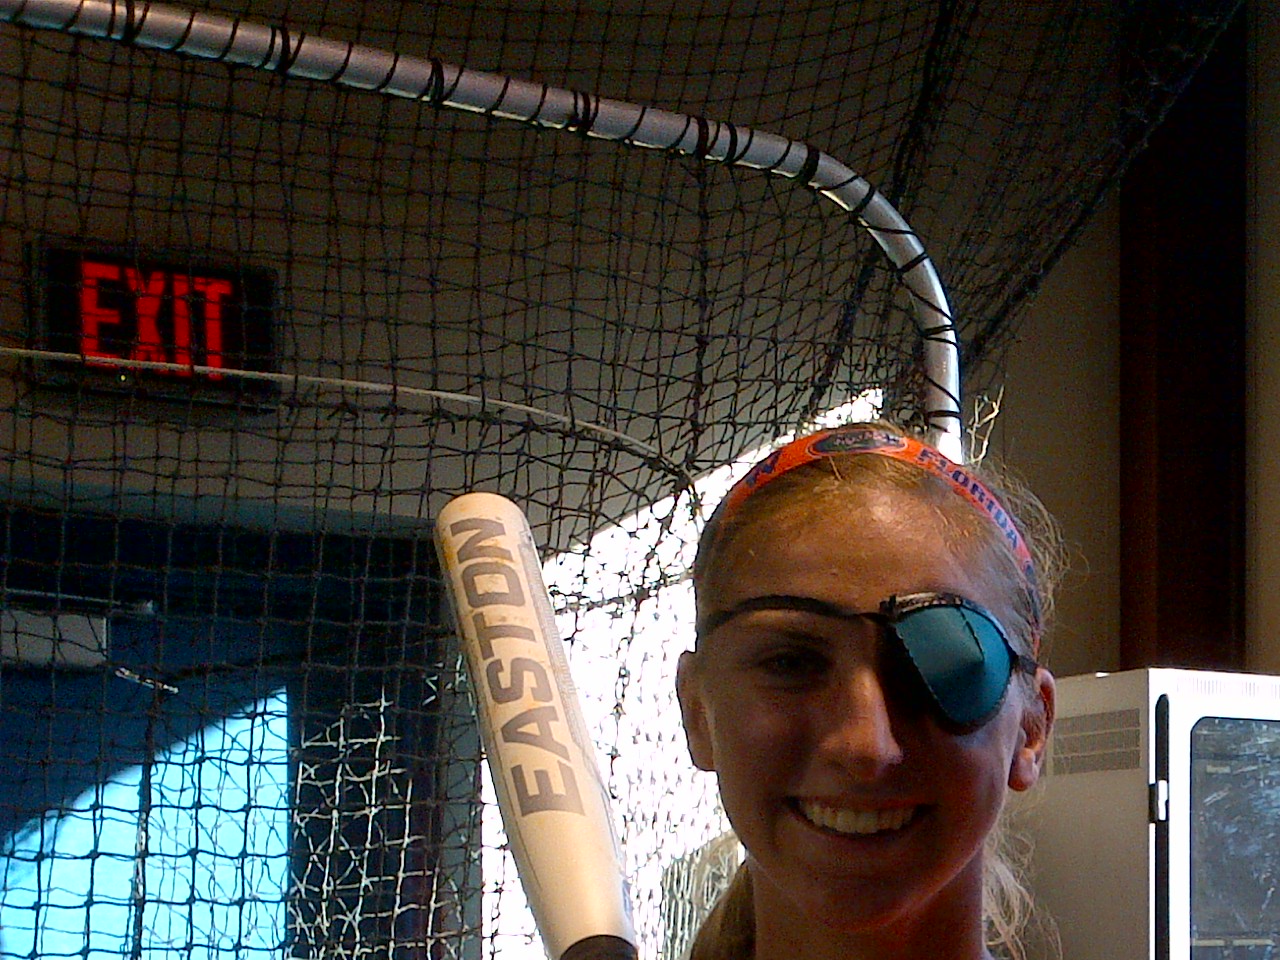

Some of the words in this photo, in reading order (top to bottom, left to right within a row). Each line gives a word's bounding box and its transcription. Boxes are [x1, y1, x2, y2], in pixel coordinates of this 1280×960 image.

[80, 261, 232, 381] EXIT
[916, 448, 1020, 550] FLORIDA
[451, 516, 587, 818] EASTON
